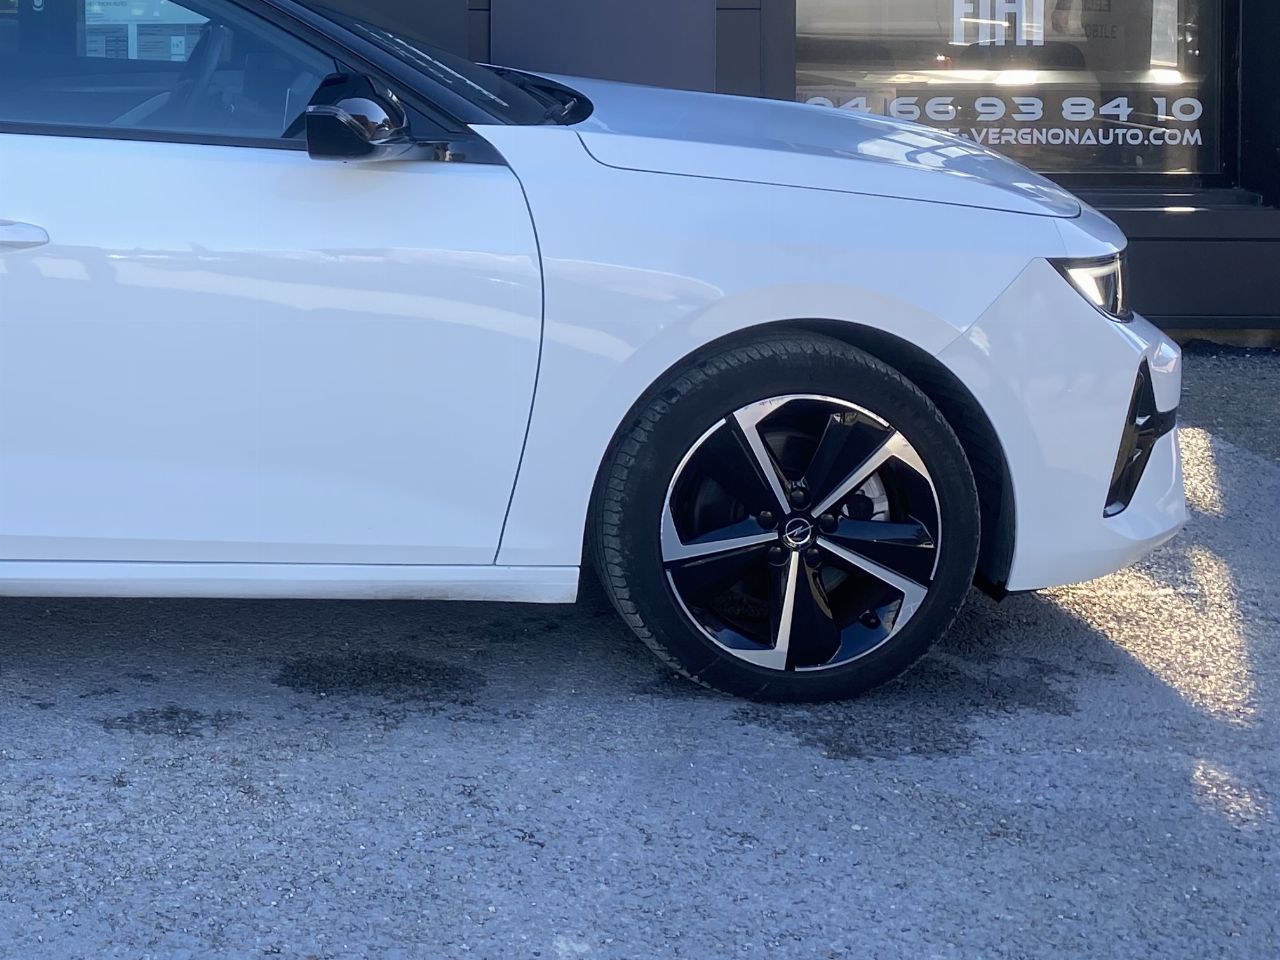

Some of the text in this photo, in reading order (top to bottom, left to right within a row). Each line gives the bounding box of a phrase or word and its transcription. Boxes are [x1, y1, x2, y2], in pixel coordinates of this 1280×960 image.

[889, 97, 961, 121] 66
[974, 97, 1044, 121] 93
[1061, 97, 1134, 121] 84
[1152, 97, 1203, 121] 10
